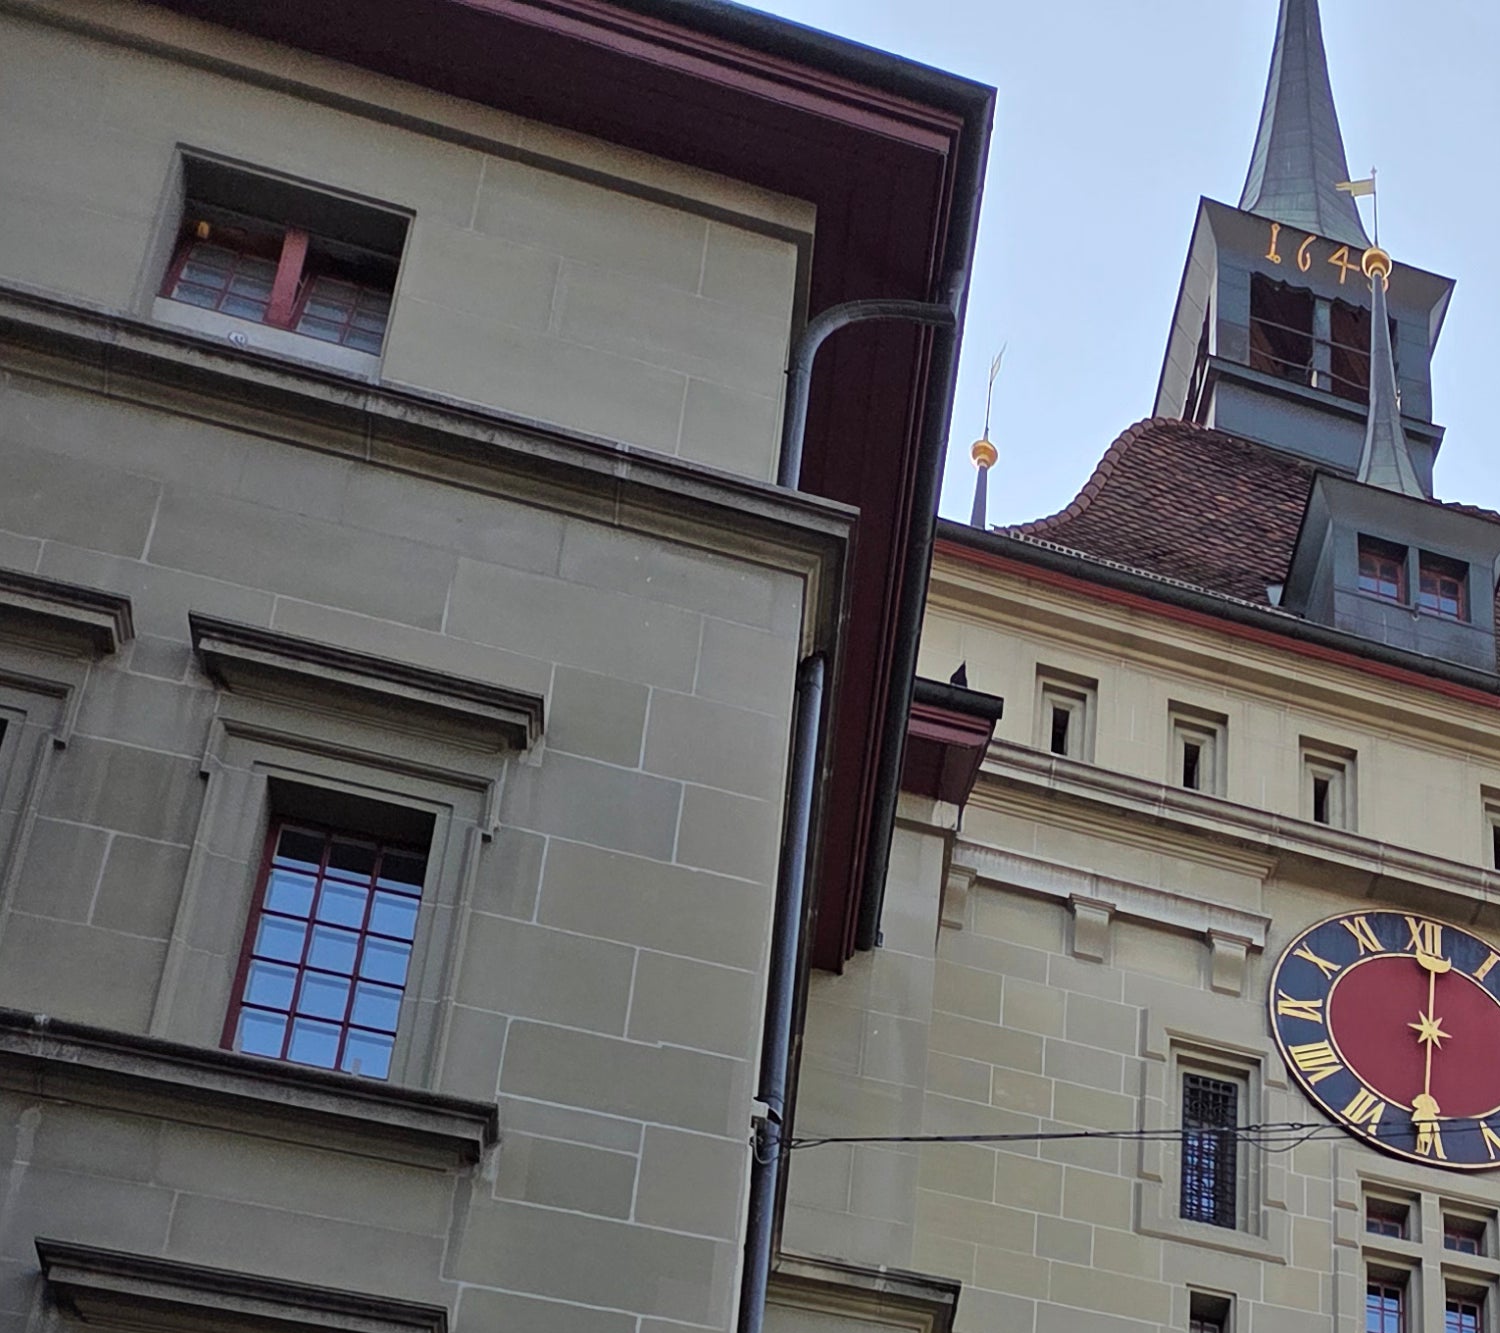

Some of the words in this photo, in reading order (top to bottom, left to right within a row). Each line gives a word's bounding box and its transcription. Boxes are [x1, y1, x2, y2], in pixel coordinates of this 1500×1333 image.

[1265, 223, 1389, 294] 164
[1404, 917, 1443, 959] XII
[1293, 942, 1341, 980] X
